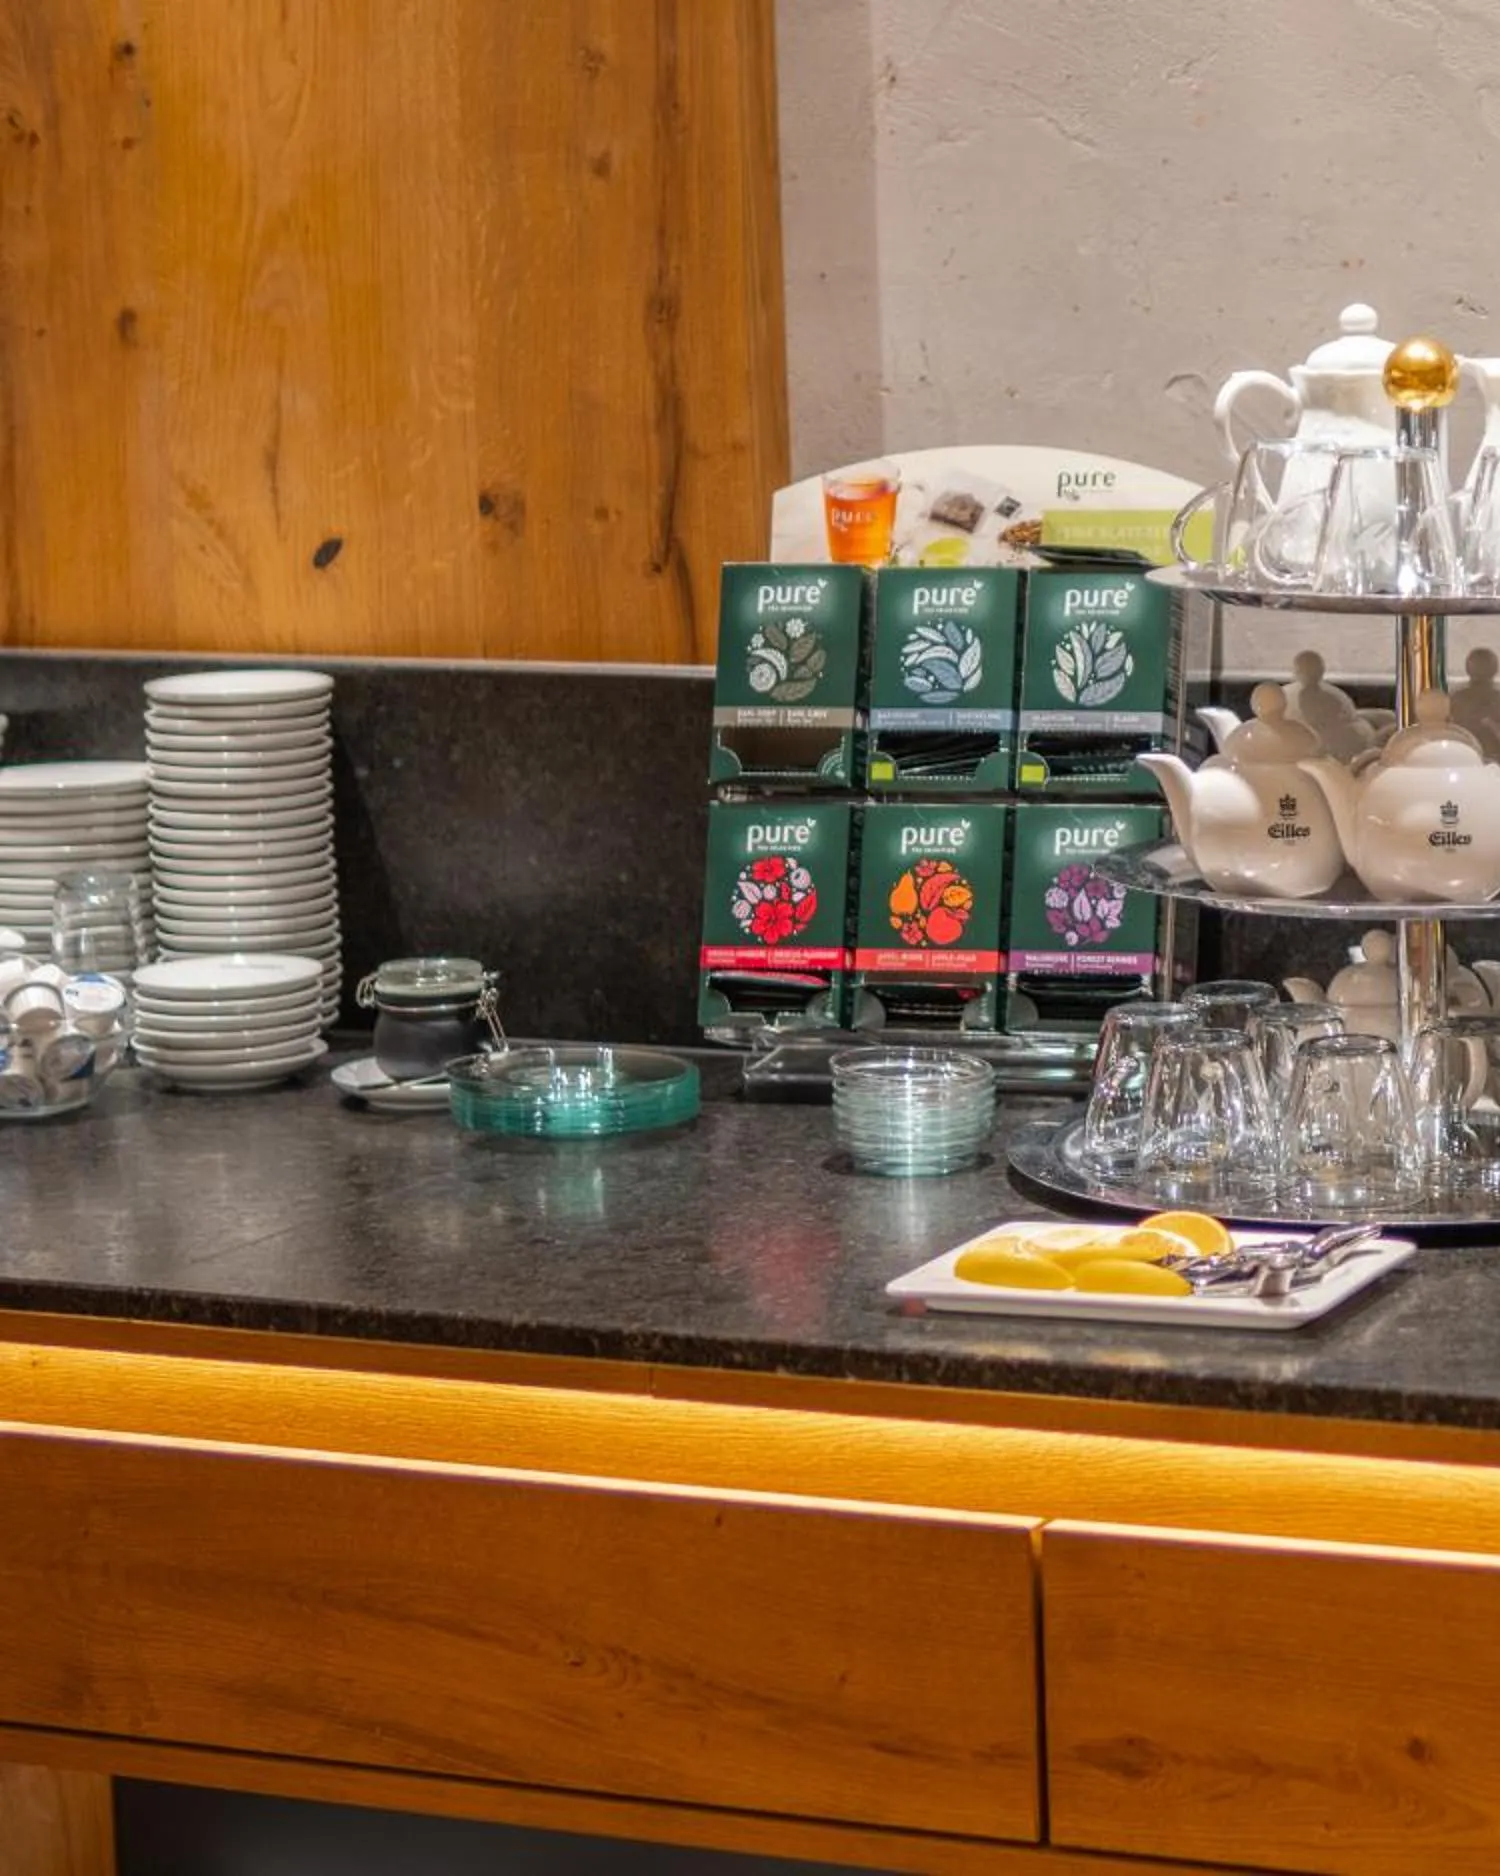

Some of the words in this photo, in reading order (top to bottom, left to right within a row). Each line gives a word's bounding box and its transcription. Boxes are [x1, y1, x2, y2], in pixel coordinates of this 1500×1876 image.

[1057, 471, 1117, 498] pure
[757, 585, 822, 613] pure
[912, 587, 977, 616] pure
[1063, 588, 1129, 617] pure
[746, 823, 811, 852] pure
[900, 826, 966, 855] pure
[1054, 827, 1120, 856] pure
[1267, 823, 1311, 839] Eilles
[1428, 831, 1473, 847] Eilles
